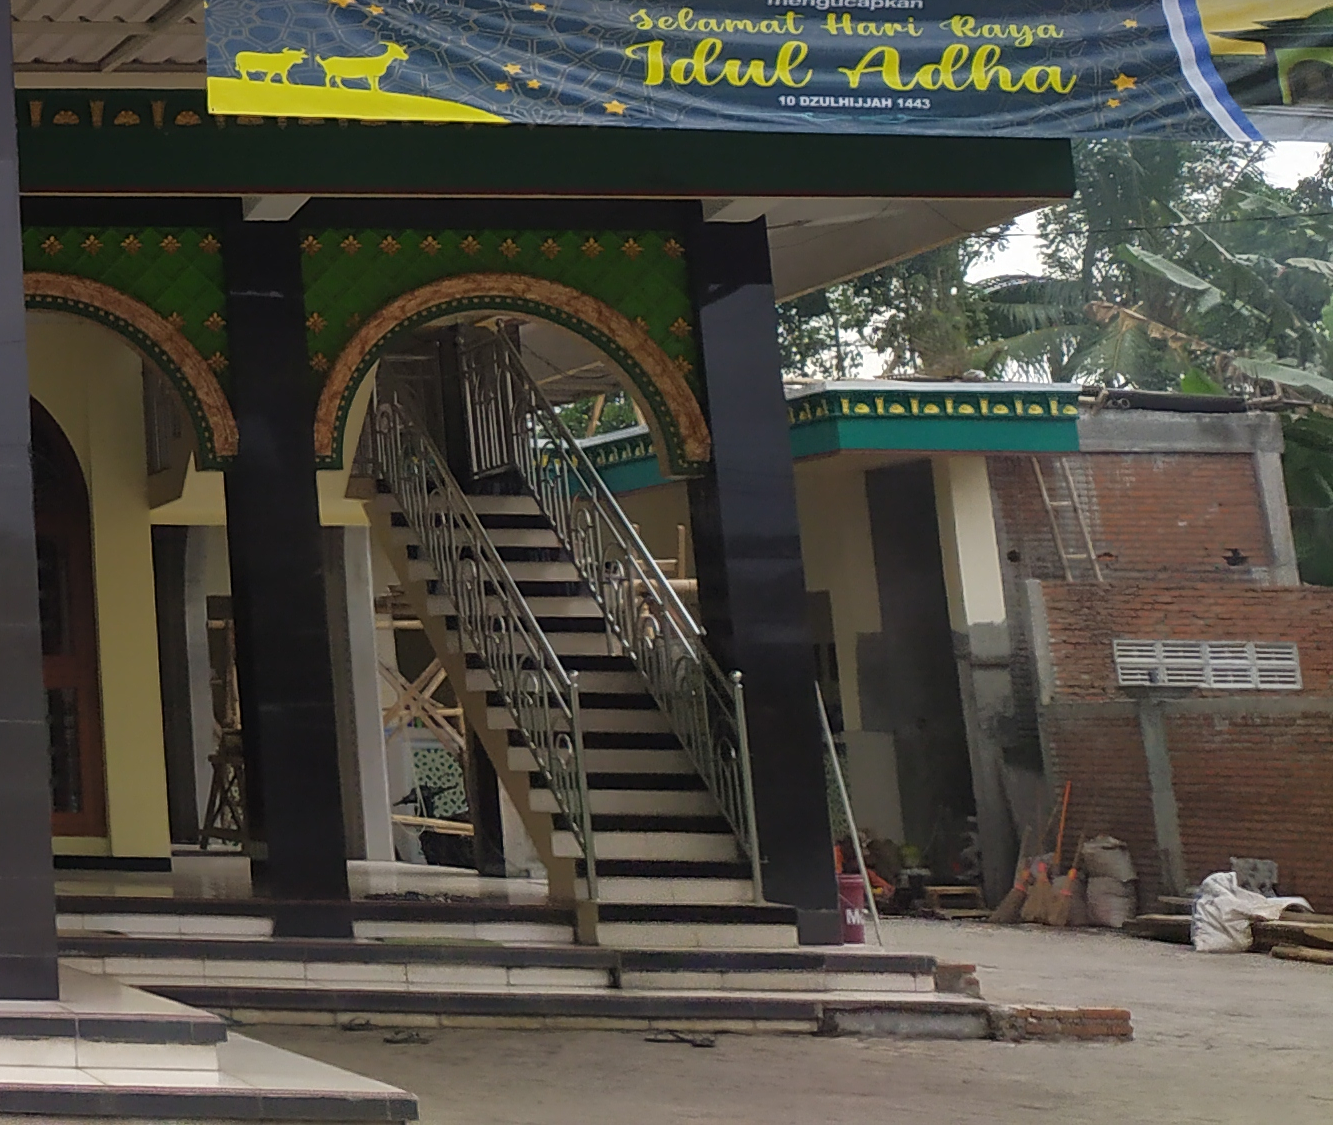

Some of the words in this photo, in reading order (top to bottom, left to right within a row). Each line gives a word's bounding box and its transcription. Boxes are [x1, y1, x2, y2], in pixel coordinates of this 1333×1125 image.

[629, 8, 804, 34] Selamat
[820, 12, 923, 37] Hari
[939, 15, 1063, 47] Raya
[624, 37, 813, 88] Idul
[837, 43, 1077, 94] Adha
[778, 95, 797, 107] 10
[799, 96, 892, 109] DZULHIJJAH
[897, 98, 931, 110] 1443
